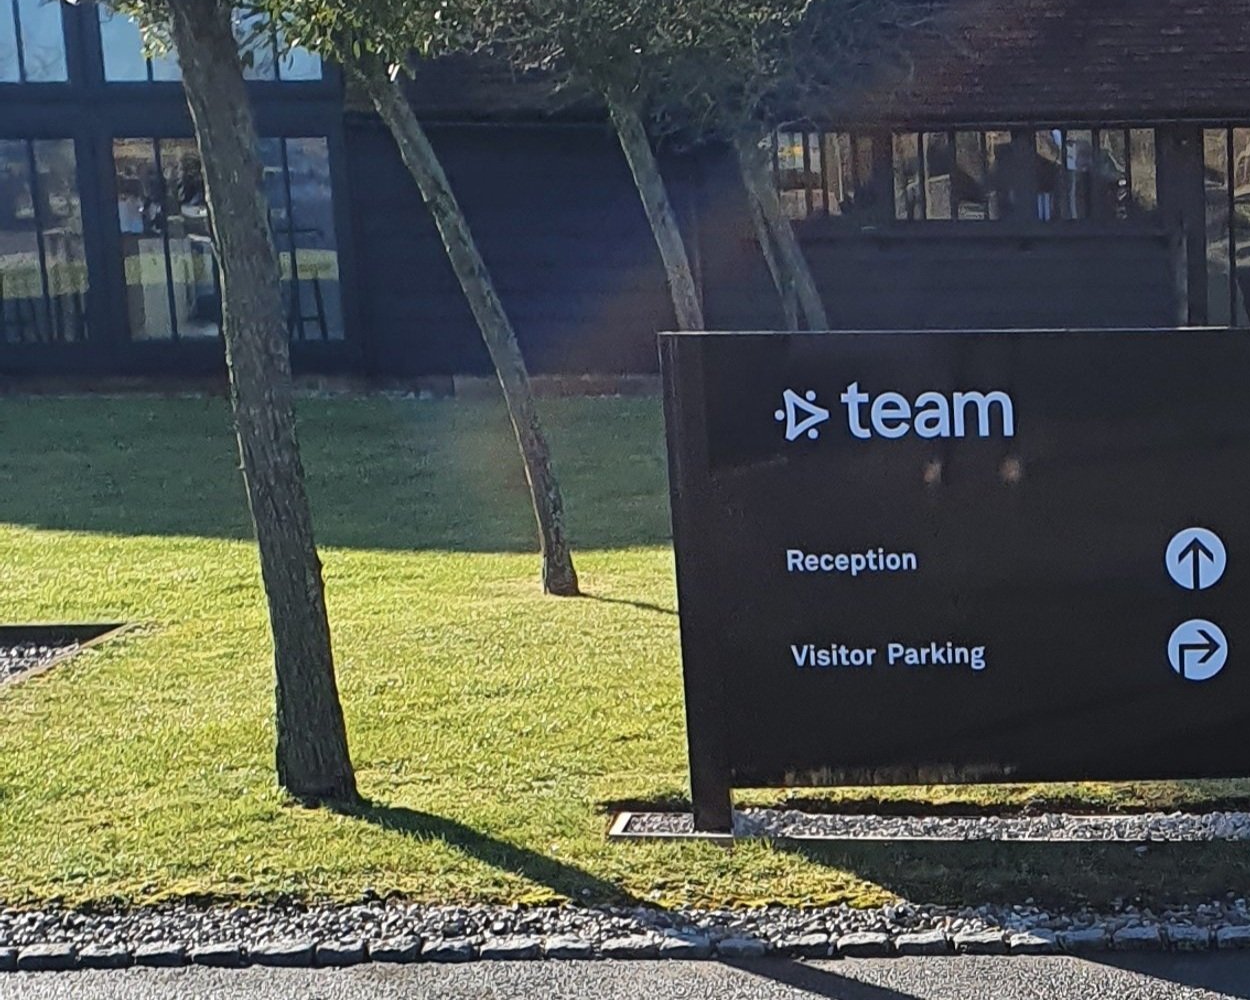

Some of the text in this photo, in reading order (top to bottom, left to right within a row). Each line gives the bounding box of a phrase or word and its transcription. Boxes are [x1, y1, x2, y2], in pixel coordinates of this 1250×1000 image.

[841, 382, 1014, 438] team
[786, 548, 917, 576] Reception
[791, 642, 986, 670] Visitor Parking
